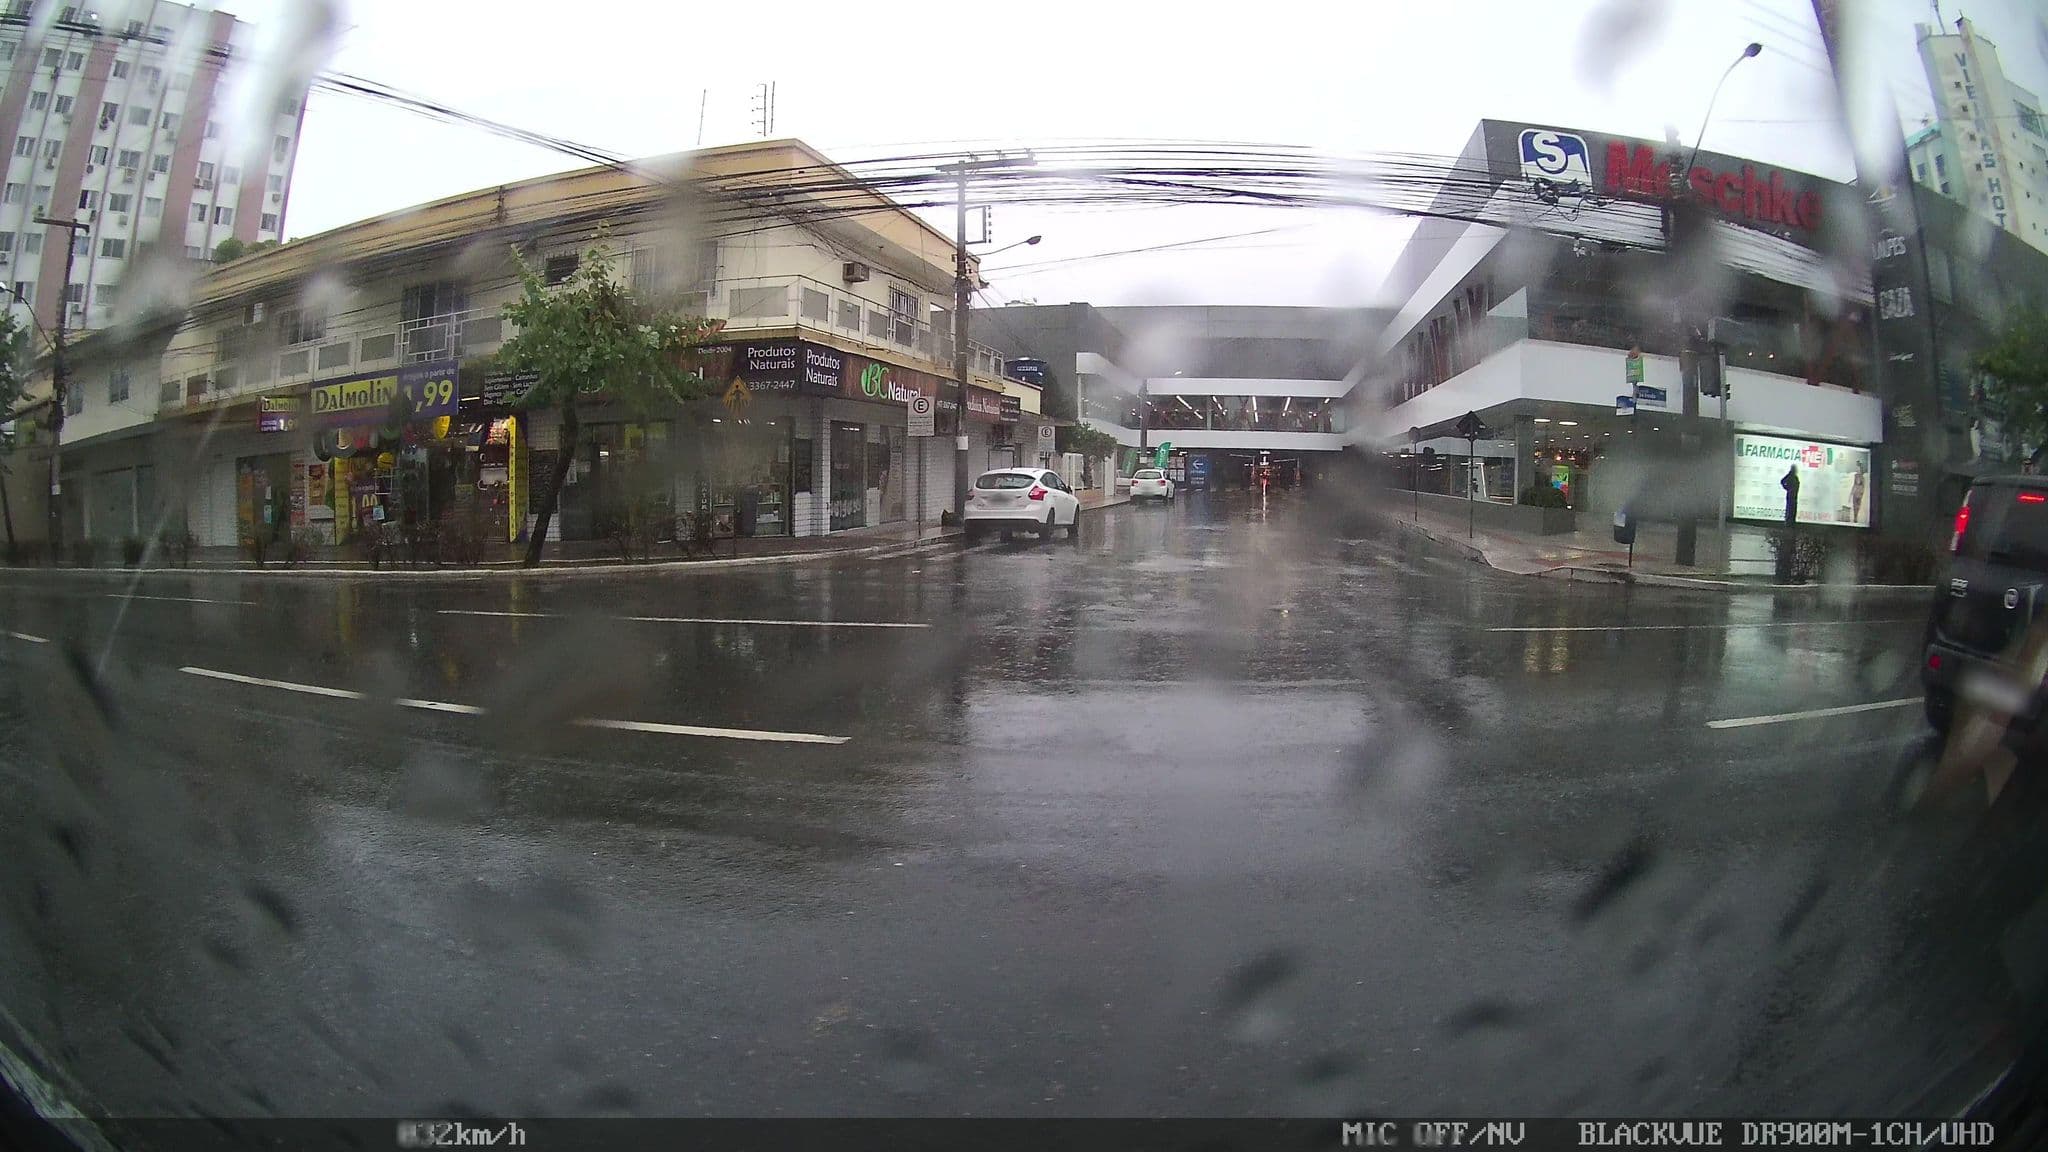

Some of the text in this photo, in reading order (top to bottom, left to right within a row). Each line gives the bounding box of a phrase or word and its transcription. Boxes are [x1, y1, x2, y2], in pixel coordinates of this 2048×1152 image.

[1605, 140, 1823, 231] Mschke
[747, 346, 796, 359] Produtos
[806, 349, 841, 370] Produtos
[749, 358, 796, 370] Naturais
[749, 379, 796, 391] 3367-2447
[805, 367, 838, 387] Naturais
